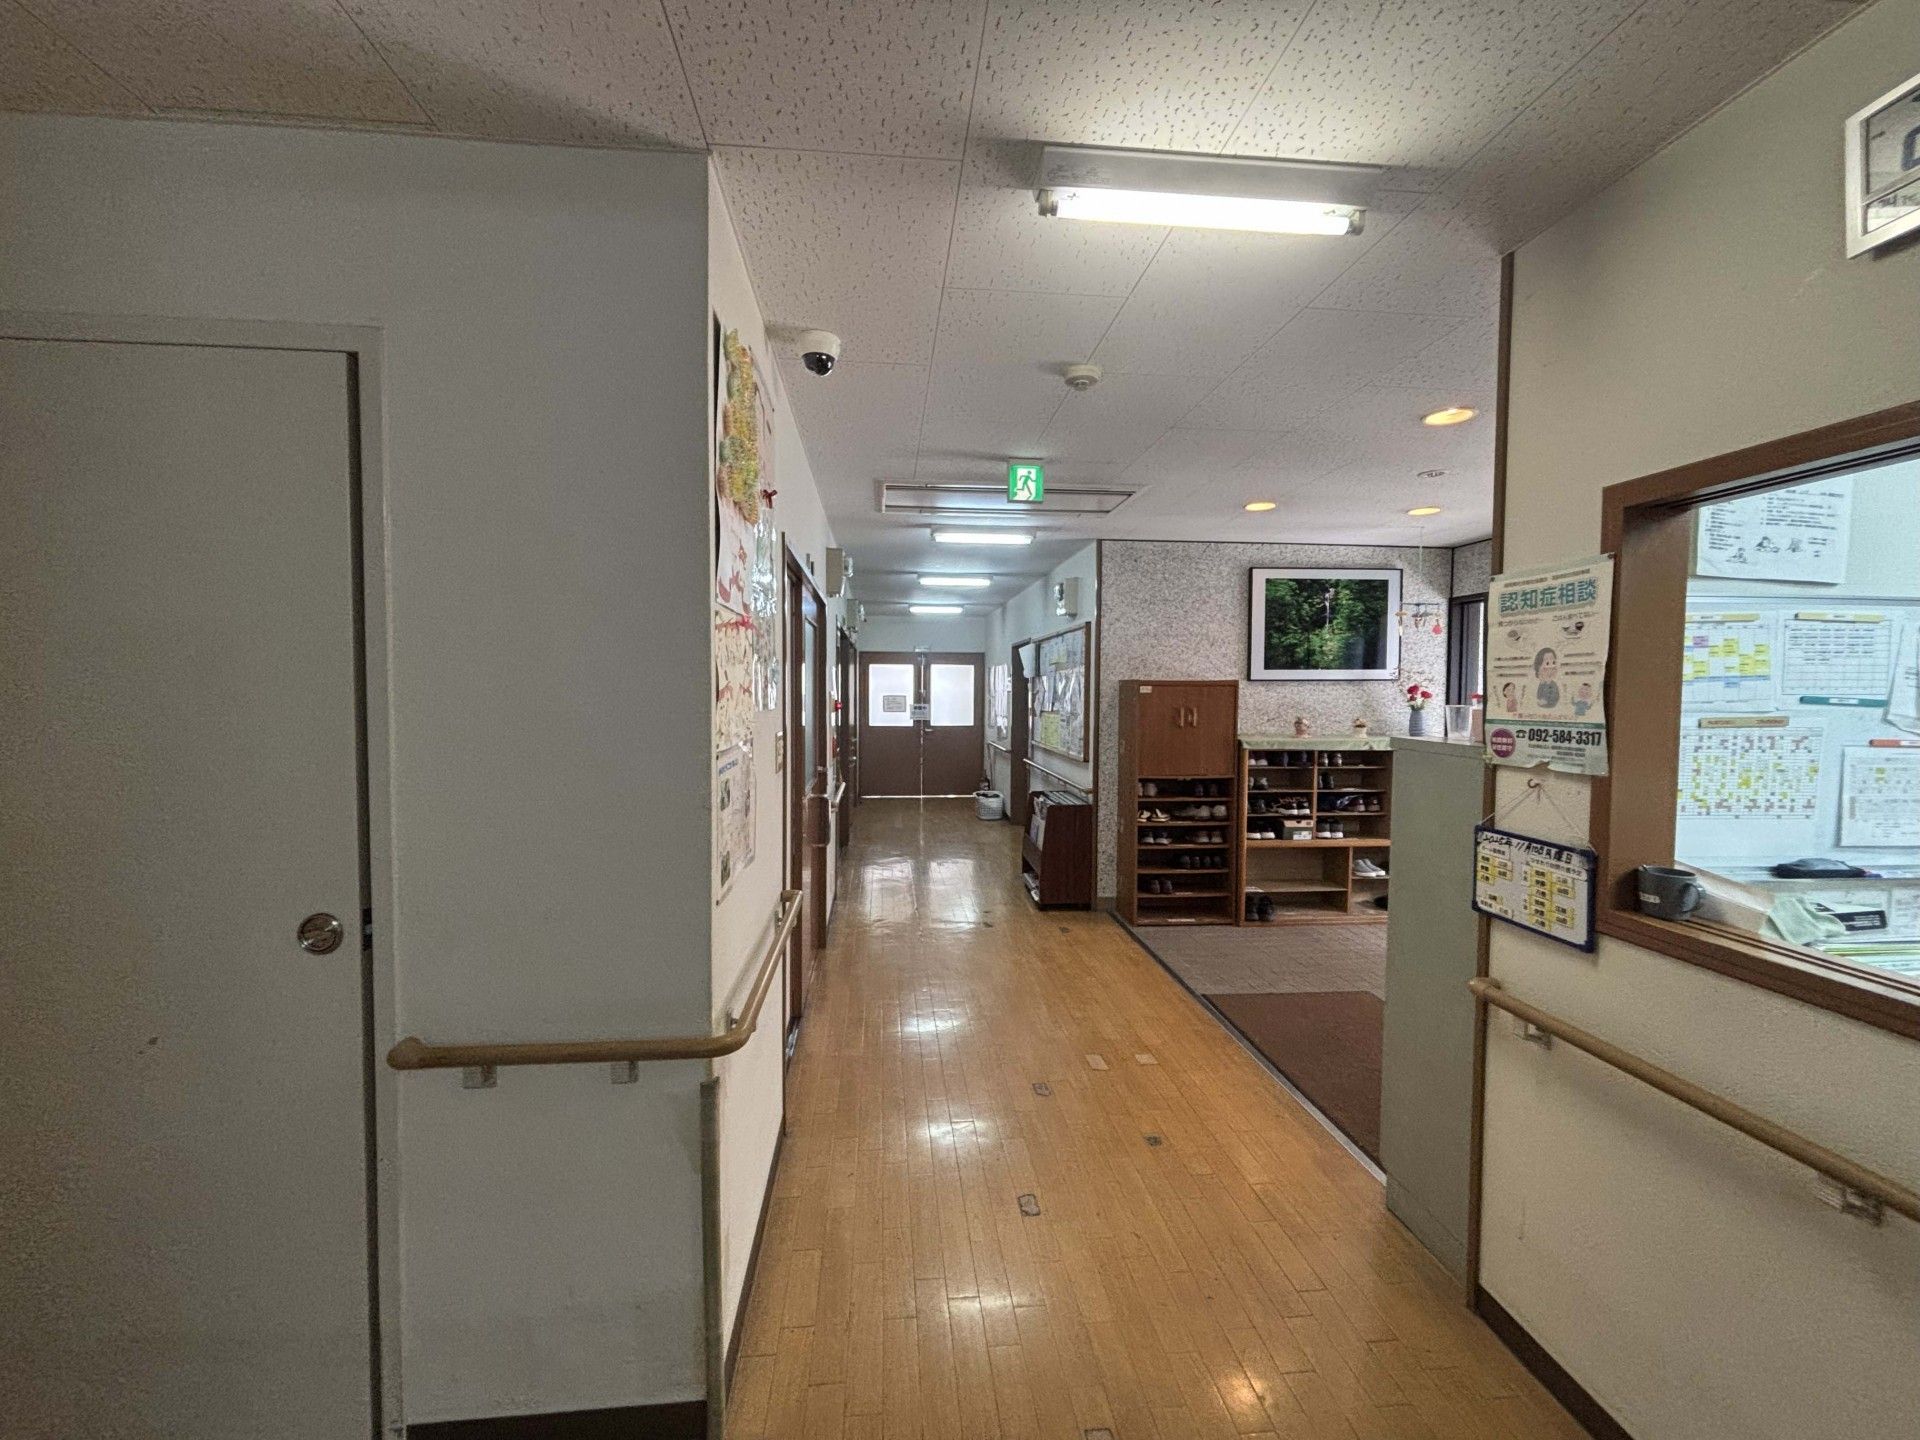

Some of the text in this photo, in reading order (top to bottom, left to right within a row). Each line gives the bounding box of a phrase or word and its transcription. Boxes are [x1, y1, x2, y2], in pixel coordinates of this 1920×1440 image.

[1500, 578, 1596, 612] 認知症相談
[1528, 728, 1602, 745] 092-584-3317
